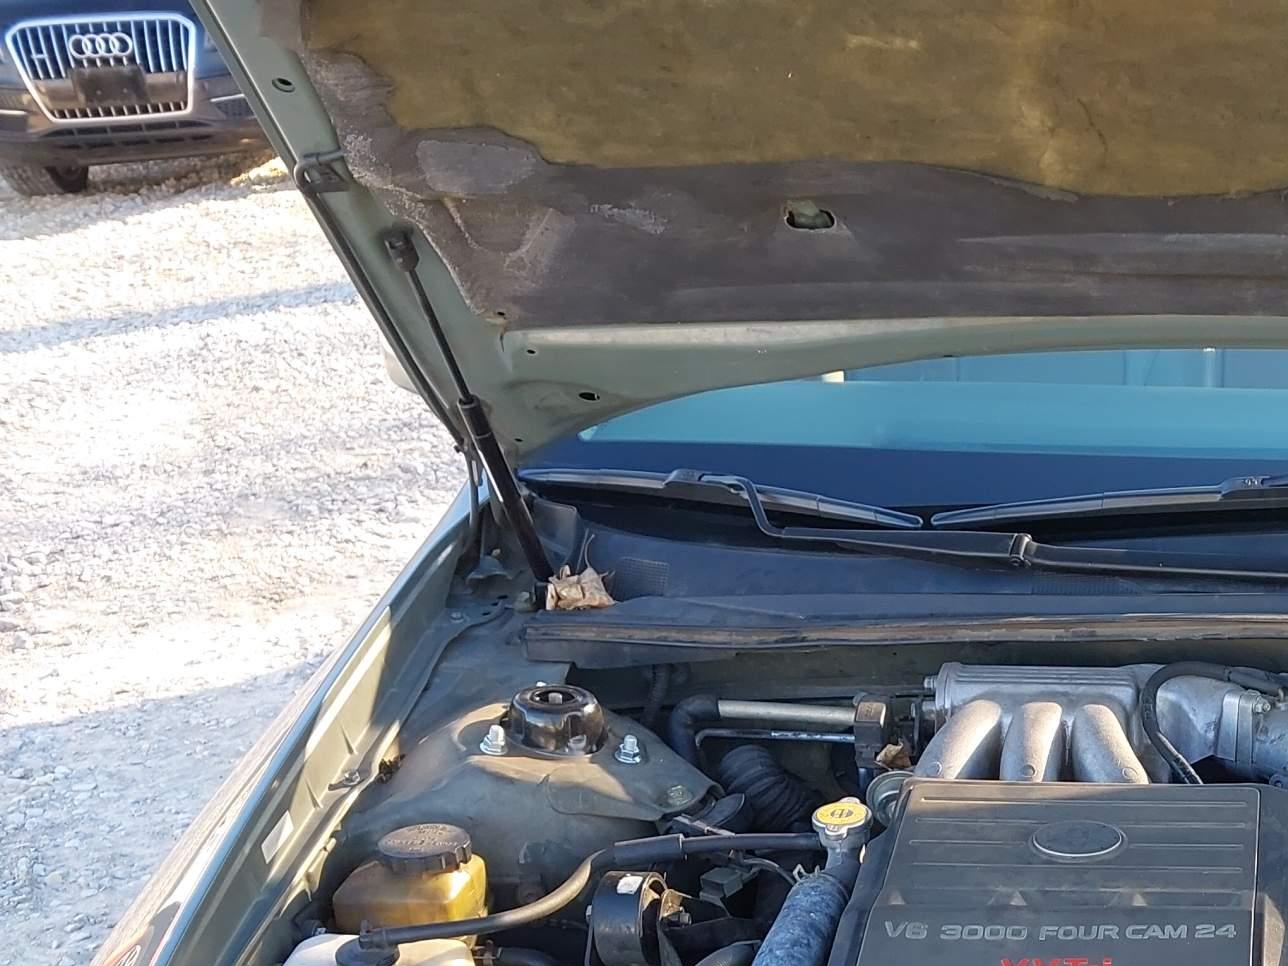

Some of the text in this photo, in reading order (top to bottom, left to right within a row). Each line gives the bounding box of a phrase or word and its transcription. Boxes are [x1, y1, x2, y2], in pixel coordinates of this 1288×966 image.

[885, 920, 1238, 941] V6 3000 FOUR CAM 24
